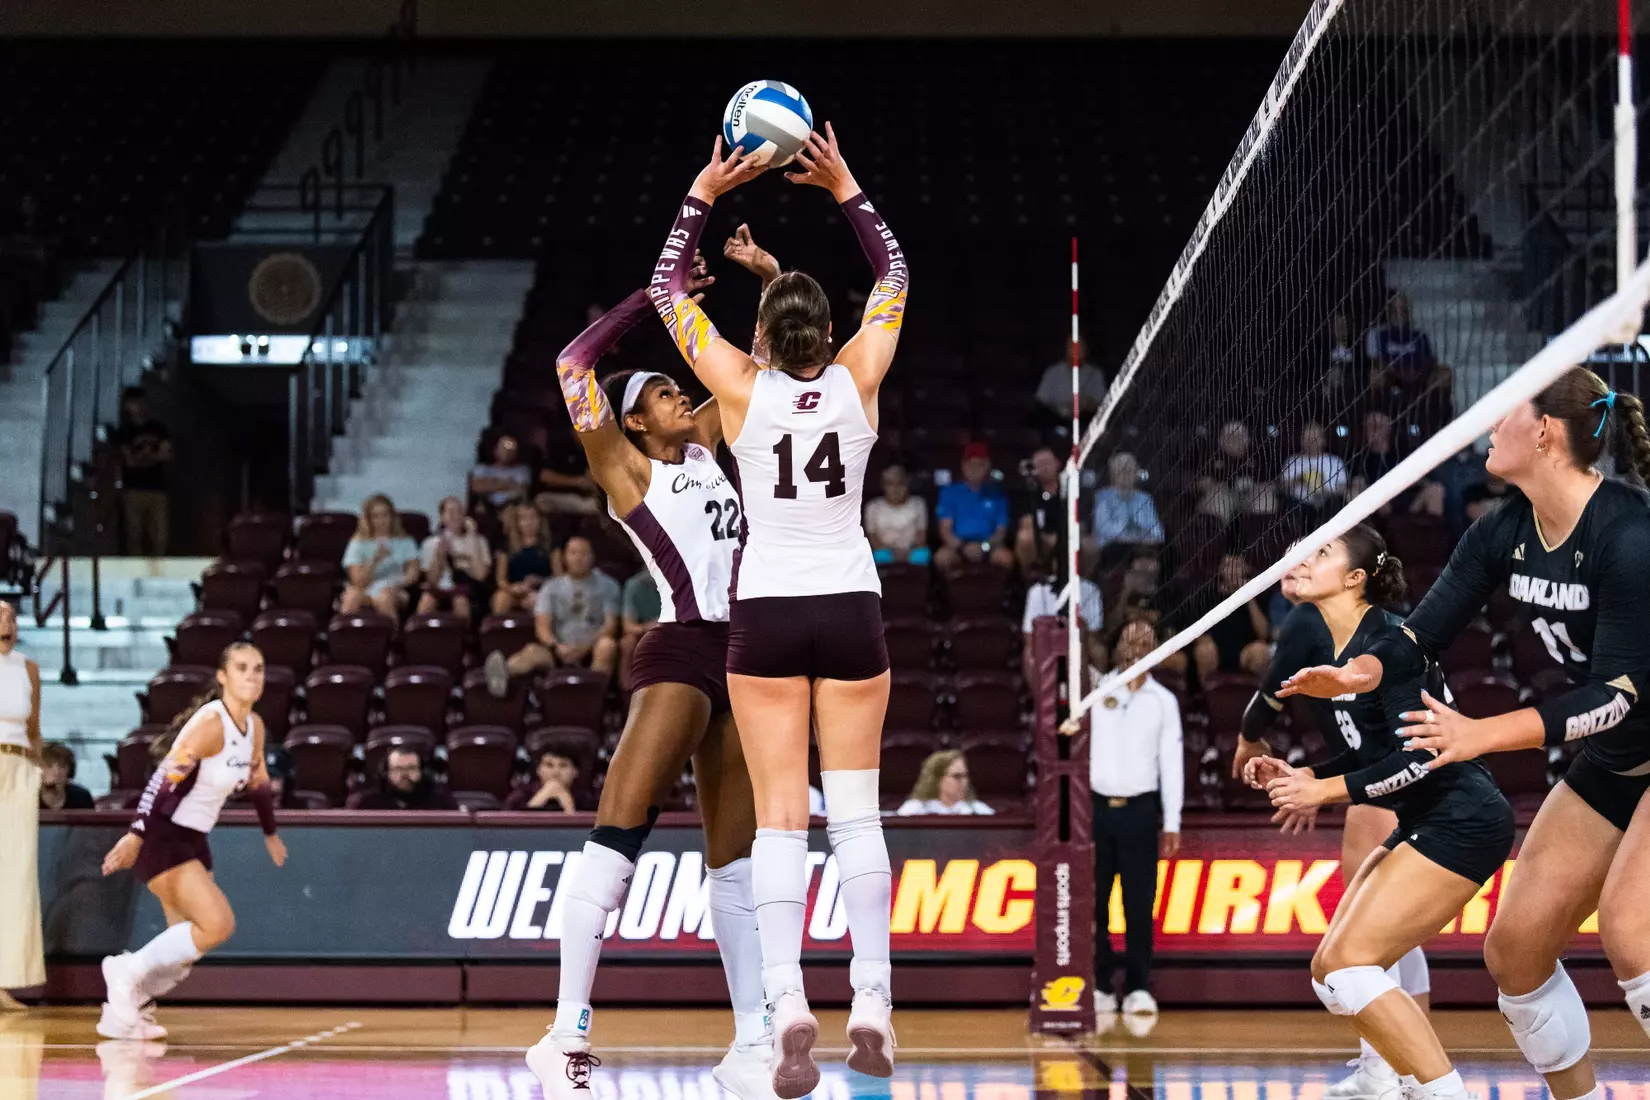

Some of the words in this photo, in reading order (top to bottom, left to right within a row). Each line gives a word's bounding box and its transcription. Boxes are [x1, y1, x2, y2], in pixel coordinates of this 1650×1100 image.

[733, 85, 757, 127] molten
[772, 432, 846, 499] 14
[705, 498, 739, 541] 22
[1509, 573, 1590, 611] OAKLAND
[1531, 617, 1588, 664] 11
[1054, 862, 1071, 909] sports
[1054, 909, 1071, 966] imports
